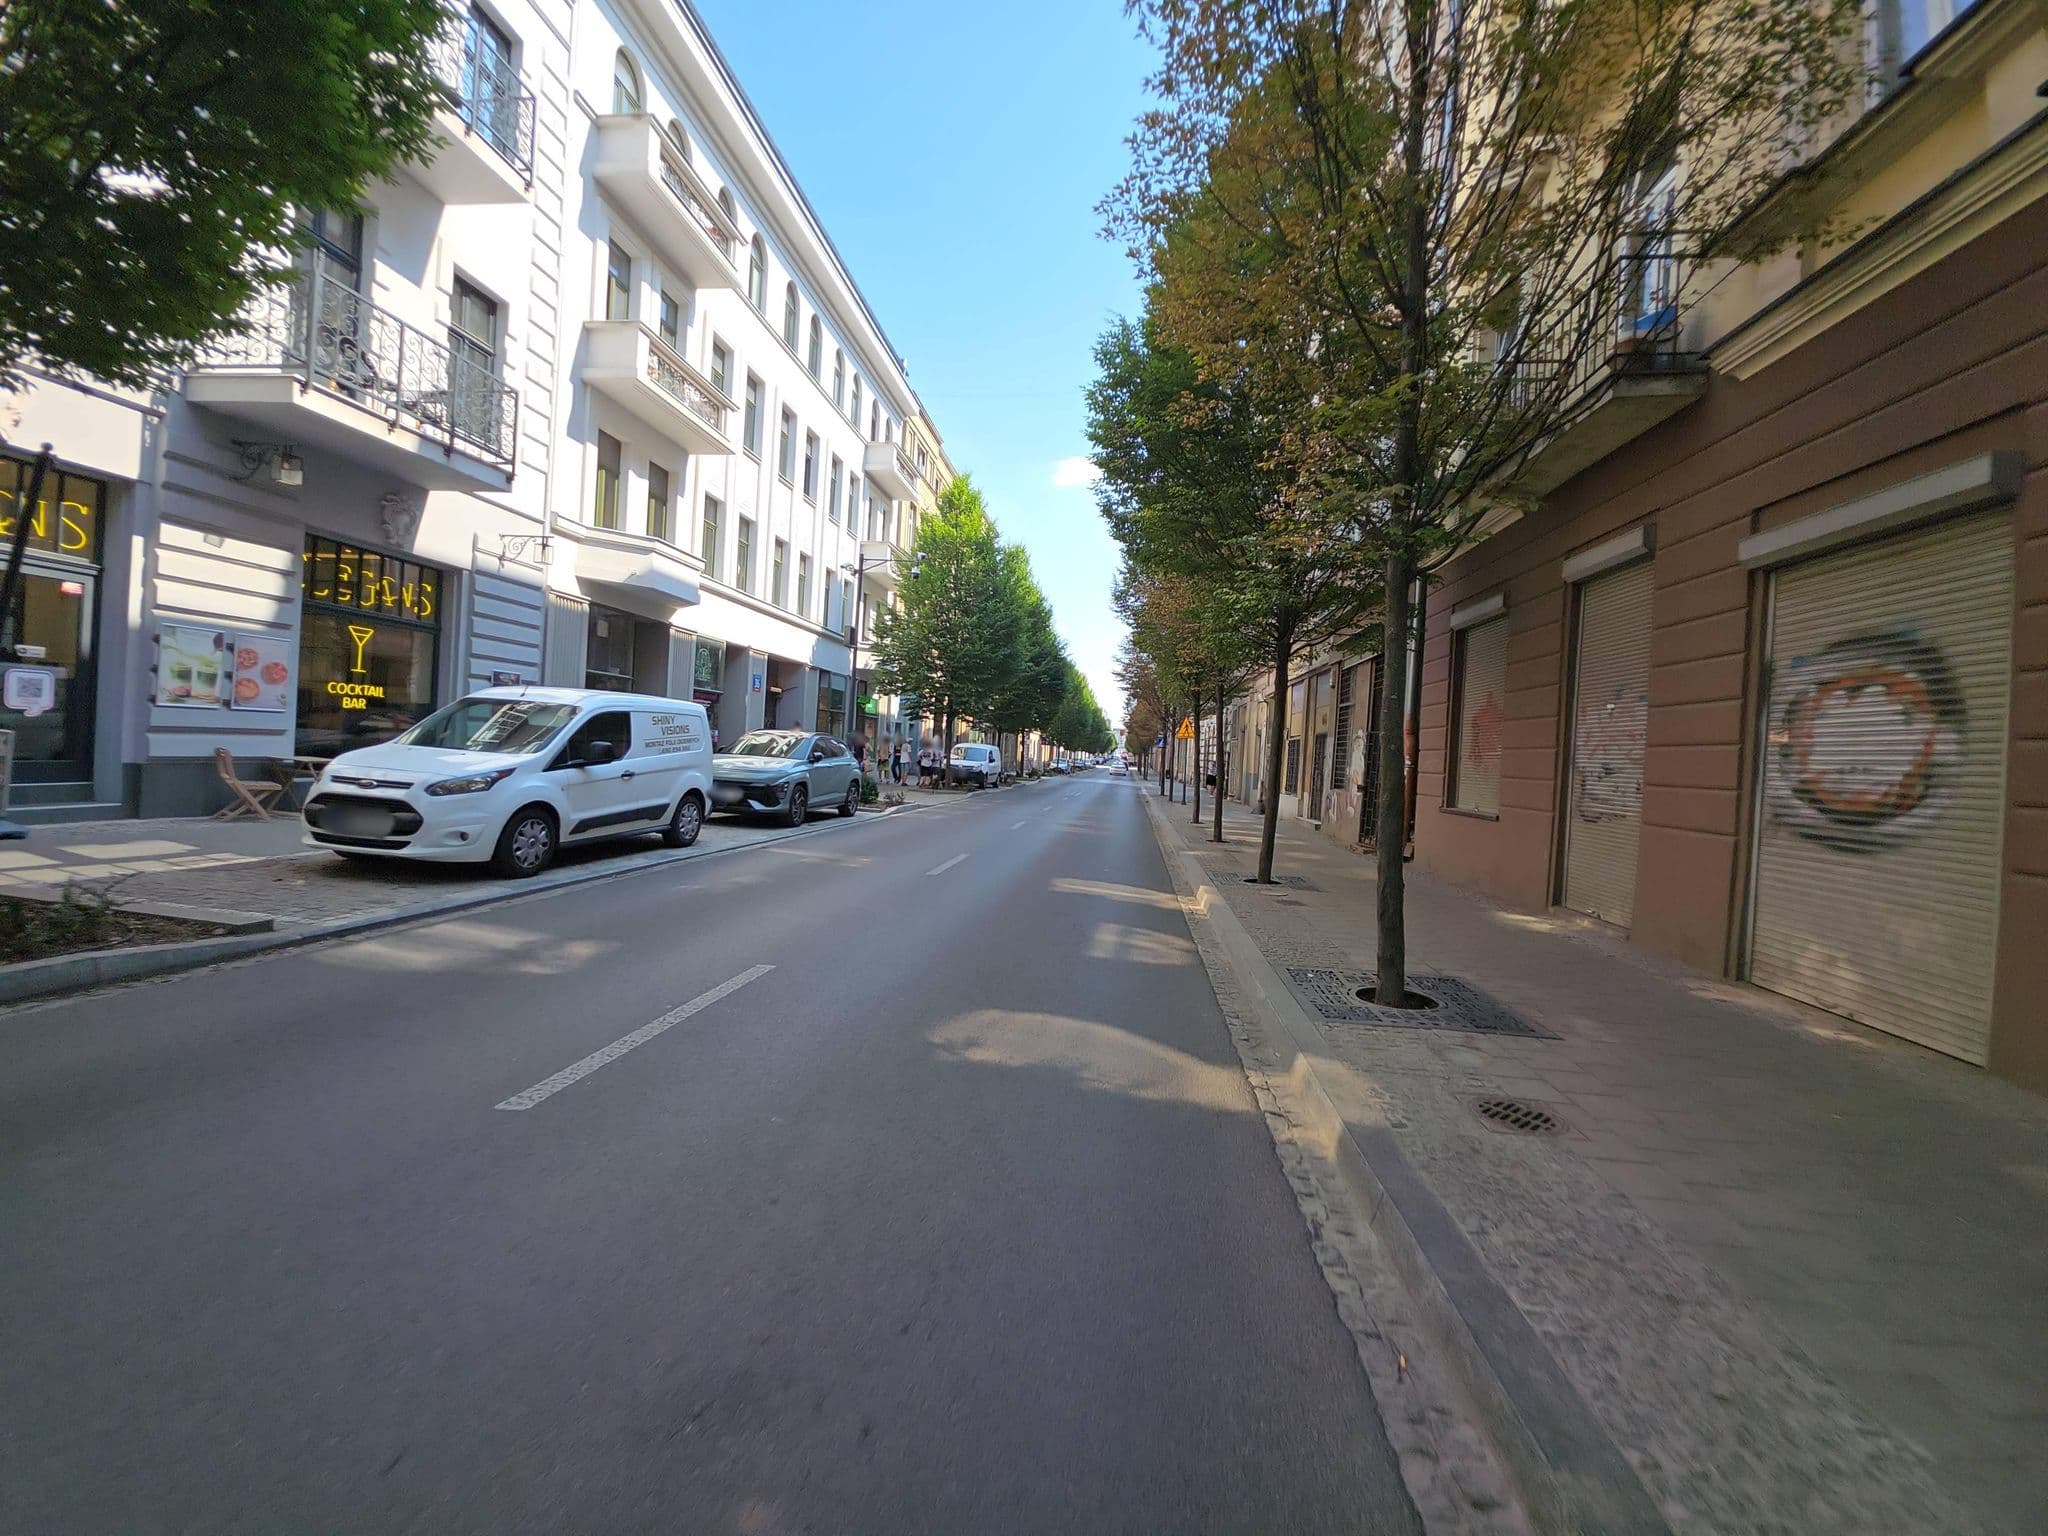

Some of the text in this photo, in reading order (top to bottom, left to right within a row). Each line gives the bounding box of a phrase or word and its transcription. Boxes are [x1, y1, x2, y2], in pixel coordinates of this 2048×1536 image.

[327, 682, 385, 698] COCKTAIL
[342, 696, 367, 709] BAR
[651, 715, 675, 726] SHINY
[661, 725, 690, 736] VISIONS
